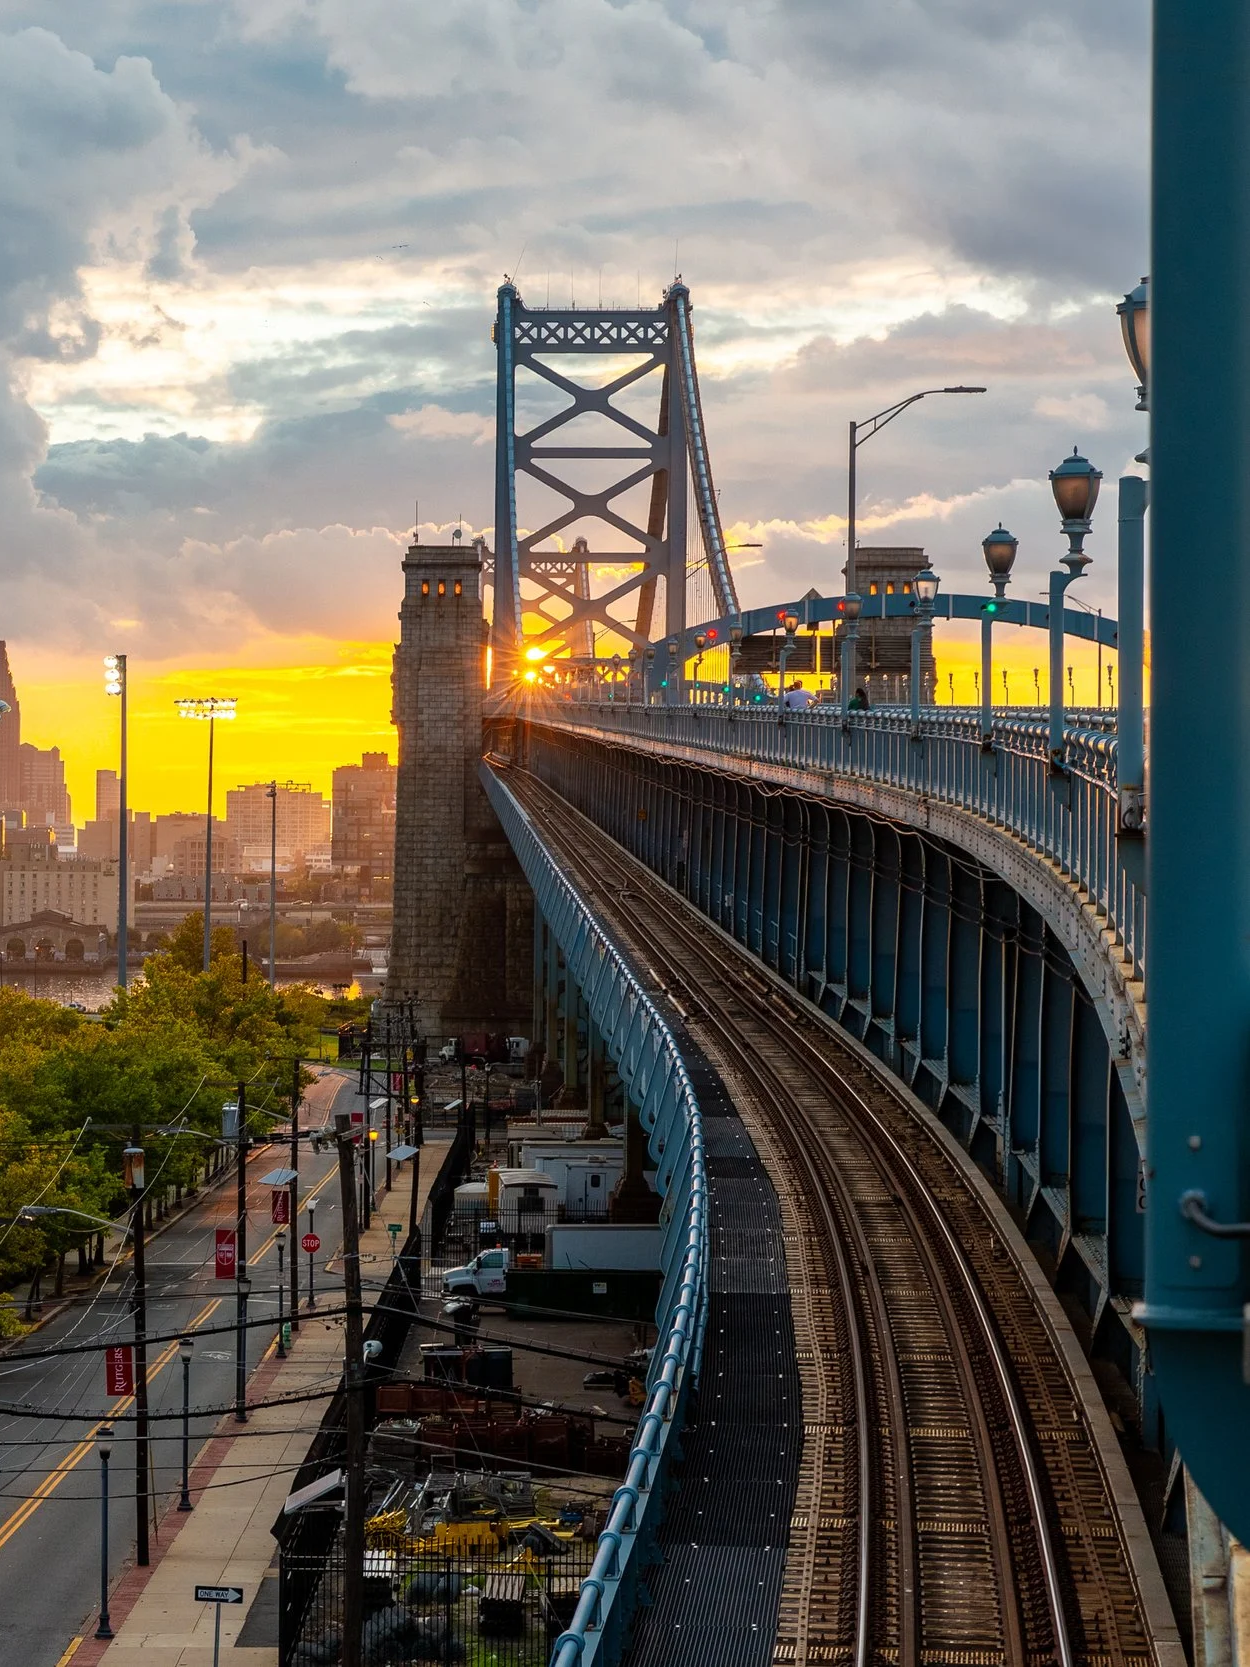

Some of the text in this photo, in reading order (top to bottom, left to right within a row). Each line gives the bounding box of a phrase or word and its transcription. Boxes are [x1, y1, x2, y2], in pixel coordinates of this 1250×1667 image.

[302, 1239, 320, 1247] STOP
[114, 1347, 127, 1392] RUTGERS
[199, 1590, 229, 1599] ONE WAY
